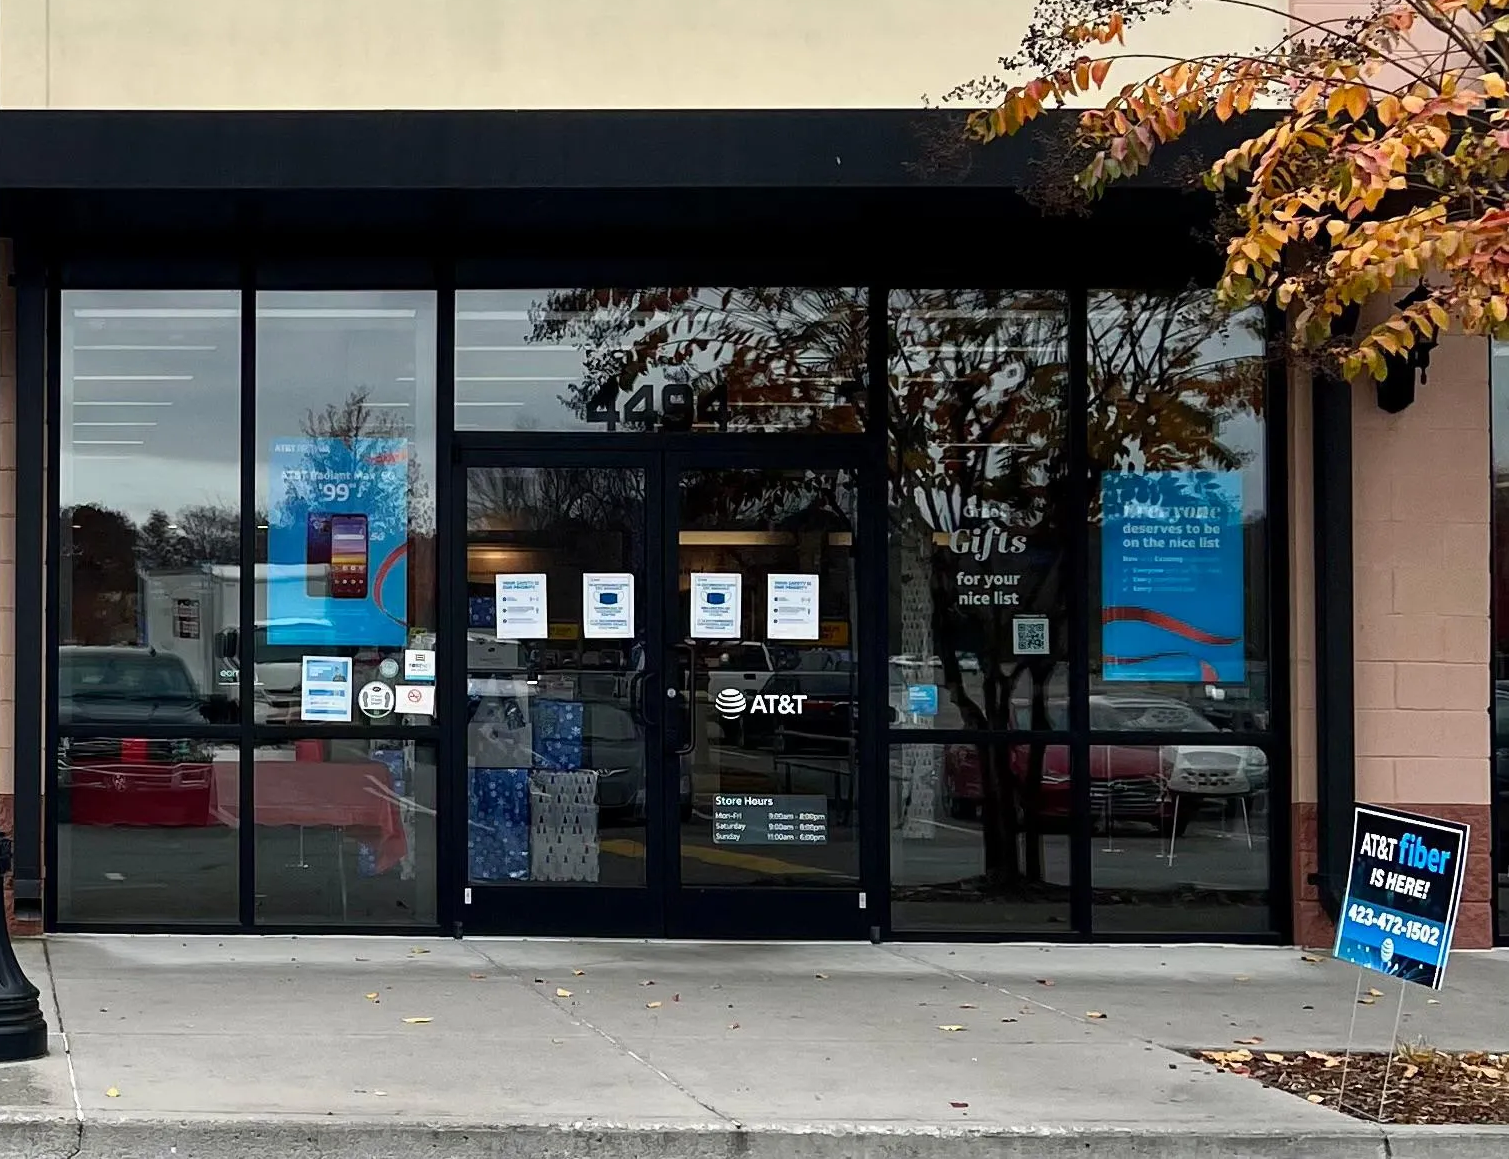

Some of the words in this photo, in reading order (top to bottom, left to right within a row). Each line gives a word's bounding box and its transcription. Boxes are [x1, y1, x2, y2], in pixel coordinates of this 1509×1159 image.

[1123, 523, 1182, 534] deserves
[1186, 524, 1200, 534] to
[1204, 523, 1221, 534] be
[950, 526, 1027, 561] Gifts
[1123, 539, 1139, 548] on
[1143, 537, 1165, 548] the
[1169, 537, 1195, 548] nice
[1200, 537, 1220, 548] list
[956, 572, 980, 585] for
[984, 574, 1021, 588] your
[959, 592, 990, 605] nice
[994, 591, 1019, 605] list
[750, 694, 808, 714] AT&T
[715, 796, 742, 806] Store
[744, 796, 773, 806] Hours
[715, 822, 746, 831] Saturday
[715, 833, 741, 841] Sunday
[1360, 832, 1398, 862] AT&T
[1398, 832, 1451, 874] fiber
[1370, 868, 1386, 887] IS
[1386, 871, 1431, 900] HERE!
[1348, 903, 1441, 947] 423-472-1502
